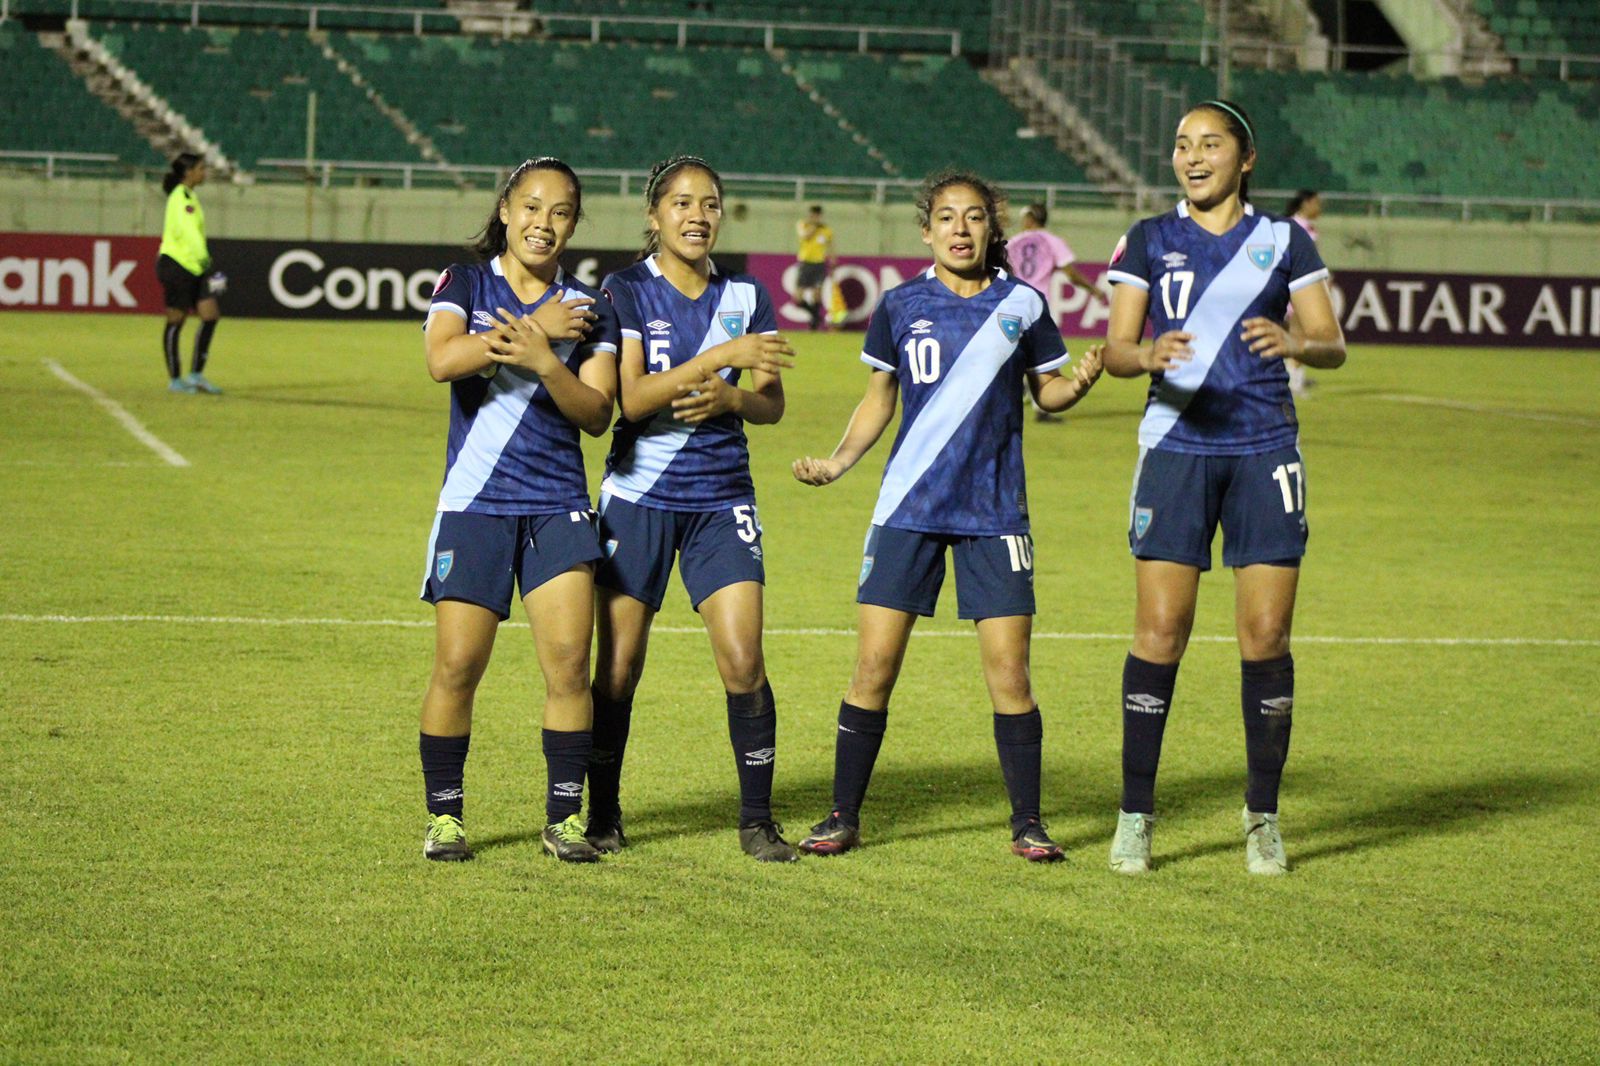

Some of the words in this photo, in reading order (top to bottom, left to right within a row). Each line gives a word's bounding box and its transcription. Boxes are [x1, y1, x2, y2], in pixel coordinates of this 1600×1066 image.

[1020, 242, 1037, 279] 8
[1160, 270, 1194, 319] 17
[1522, 284, 1600, 336] AI
[649, 339, 671, 374] 5
[904, 337, 940, 384] 10
[1272, 462, 1301, 514] 17
[732, 504, 757, 543] 5
[1126, 702, 1164, 714] umbro
